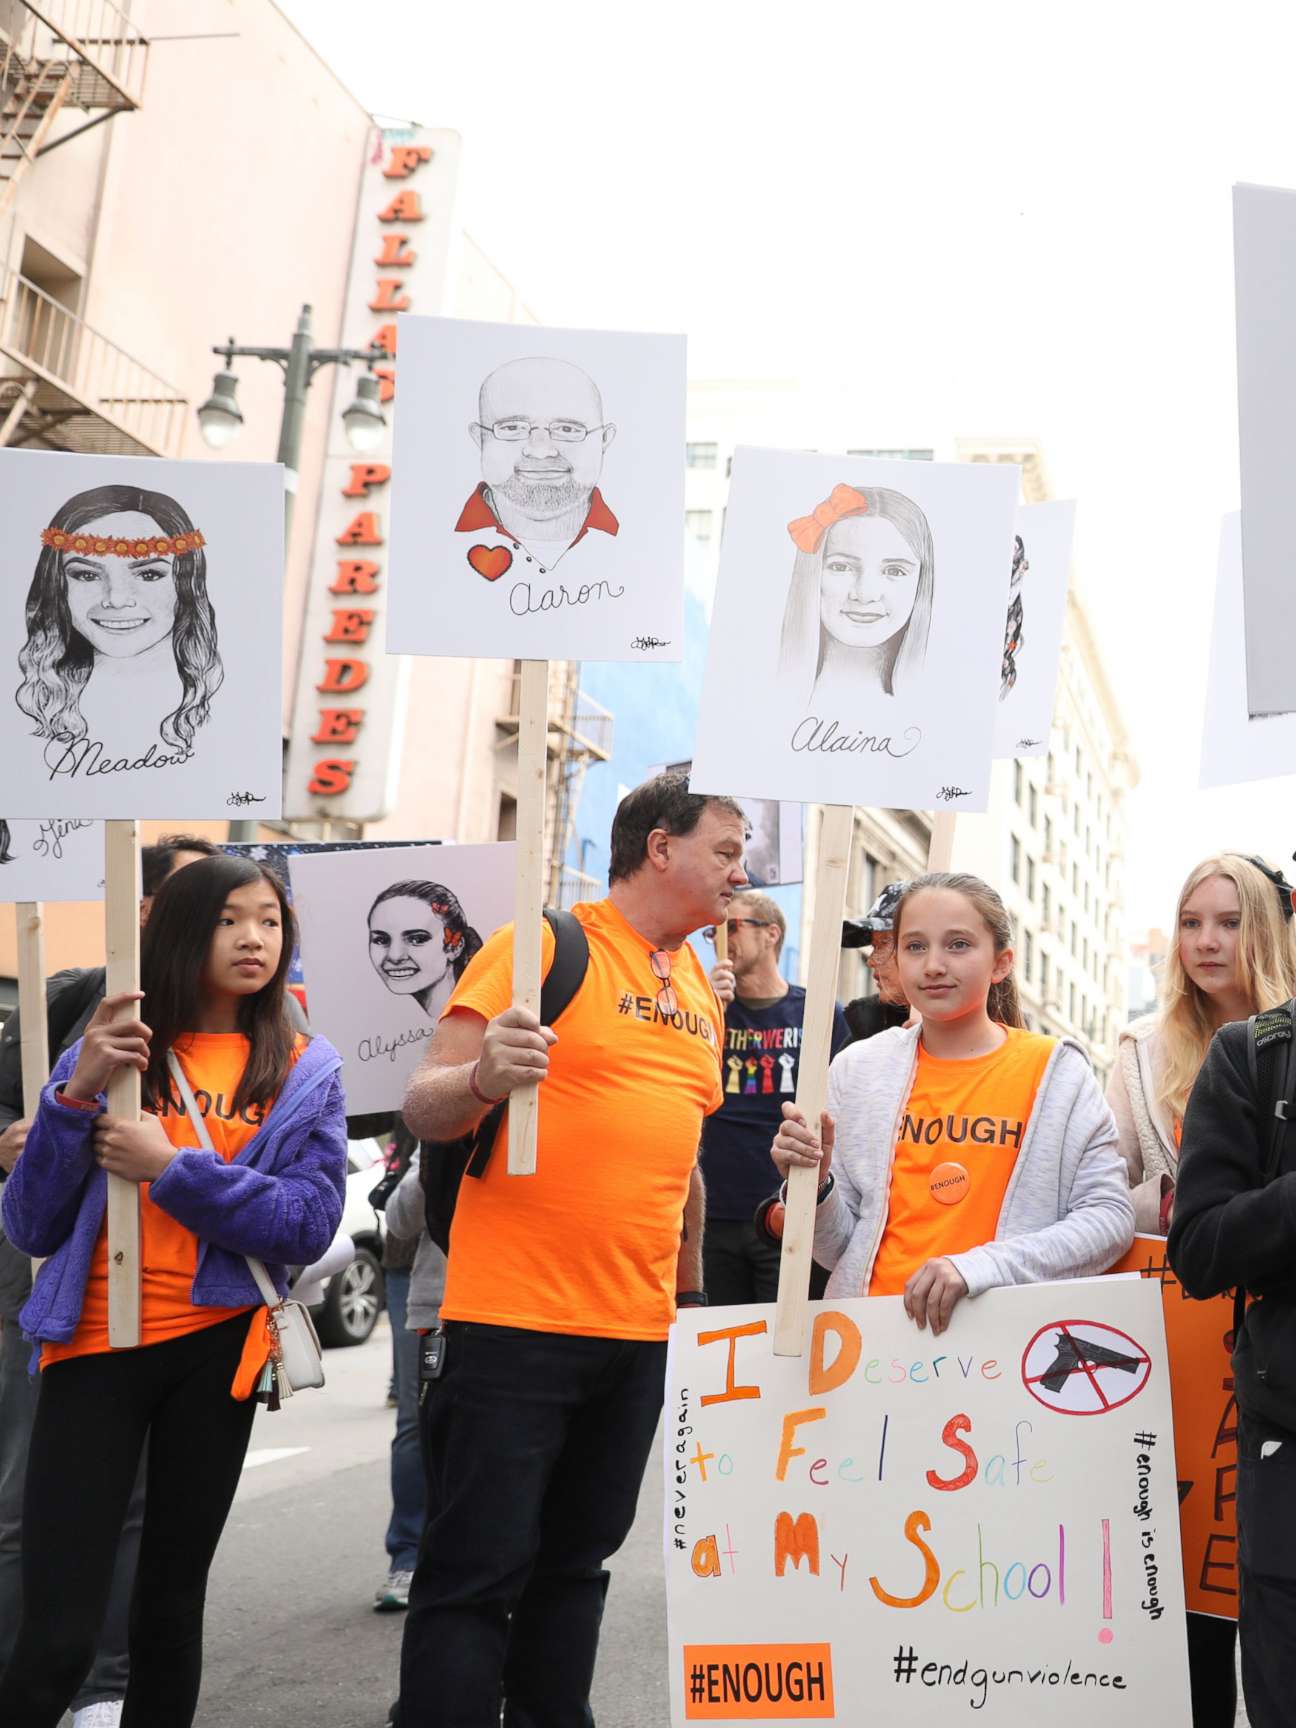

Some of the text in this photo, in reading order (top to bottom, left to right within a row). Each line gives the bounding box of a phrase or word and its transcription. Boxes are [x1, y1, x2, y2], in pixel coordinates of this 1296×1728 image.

[509, 579, 625, 615] Aaron
[308, 463, 391, 796] PAREDES
[43, 730, 195, 780] Meadow
[790, 716, 921, 758] Alaina
[358, 1025, 434, 1062] Alyssa
[930, 1175, 966, 1191] #ENOUGH
[697, 1310, 1003, 1407] I Deserve
[673, 1388, 690, 1551] #neveragain
[689, 1407, 1055, 1491] to Feel Safe
[691, 1524, 739, 1577] at
[1133, 1430, 1166, 1622] #enough is enough
[690, 1661, 825, 1704] #ENOUGH
[893, 1646, 1126, 1708] #endgunviolence
